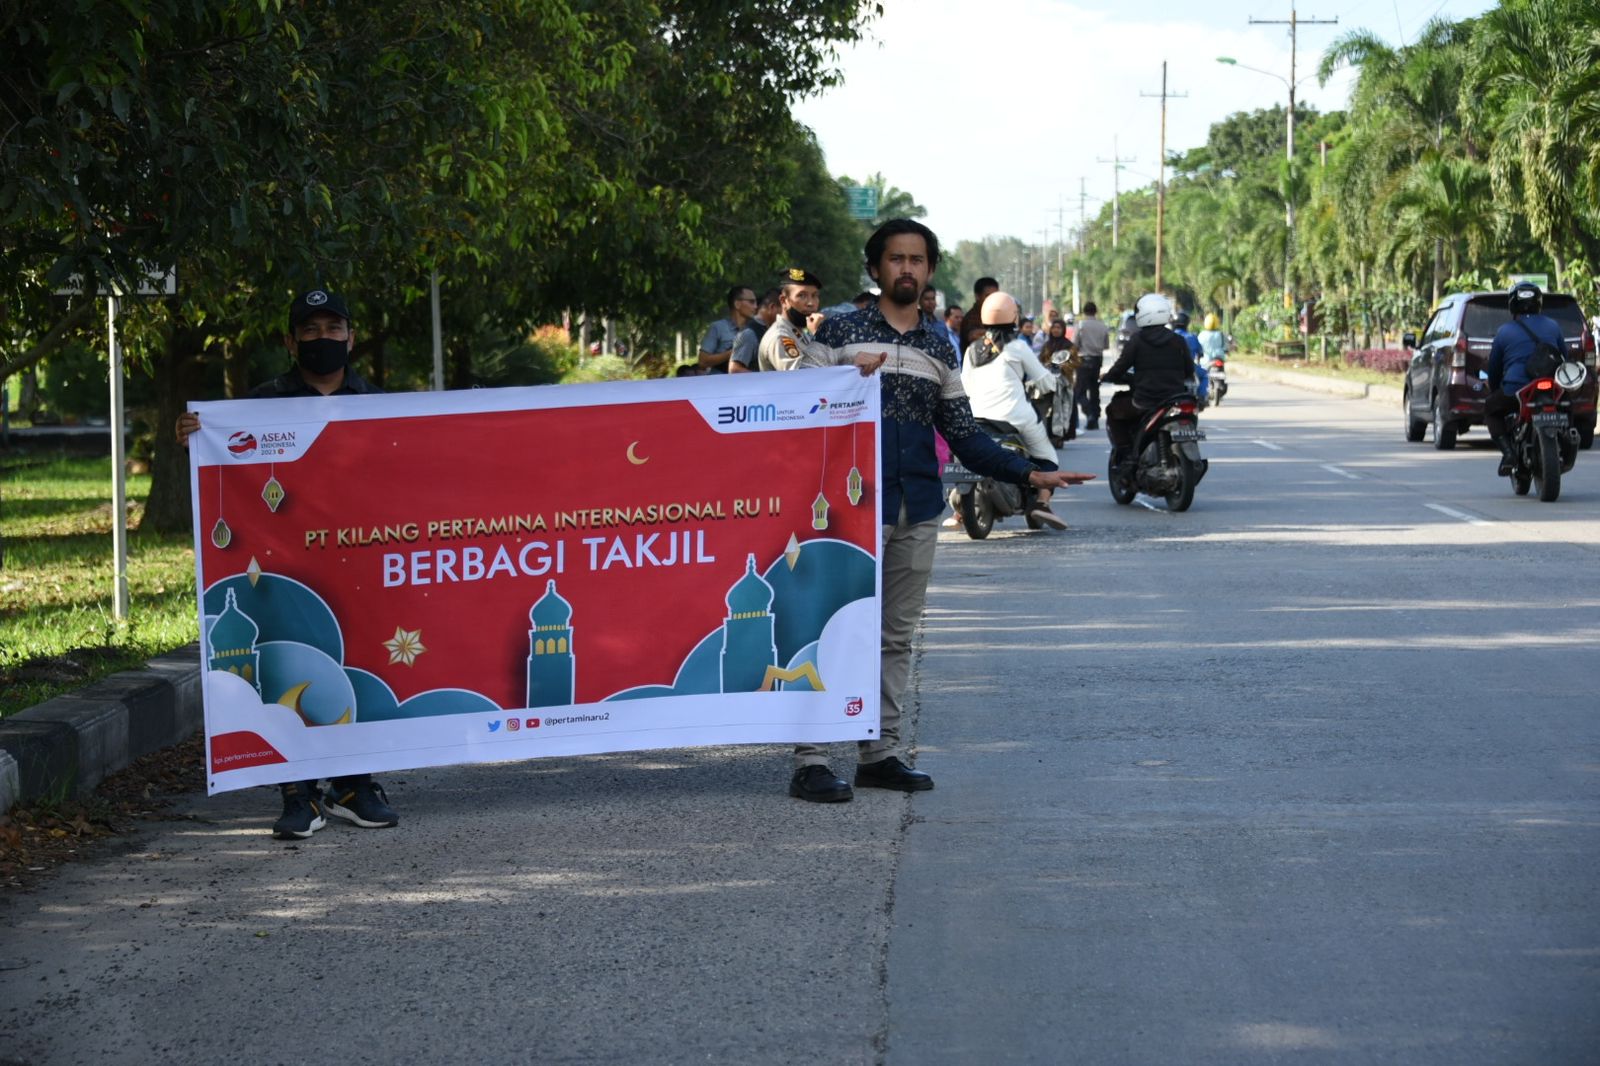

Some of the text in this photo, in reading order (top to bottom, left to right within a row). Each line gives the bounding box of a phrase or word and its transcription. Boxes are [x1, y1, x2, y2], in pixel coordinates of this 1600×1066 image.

[830, 399, 865, 409] PERTAMINA
[261, 432, 296, 442] ASEAN
[260, 441, 296, 449] INDONESIA
[304, 496, 781, 548] PT KILANG PERTAMINA INTERNASIONAL RU II
[382, 529, 716, 588] BERBAGI TAKJIL
[544, 712, 610, 727] @pertaminaru2
